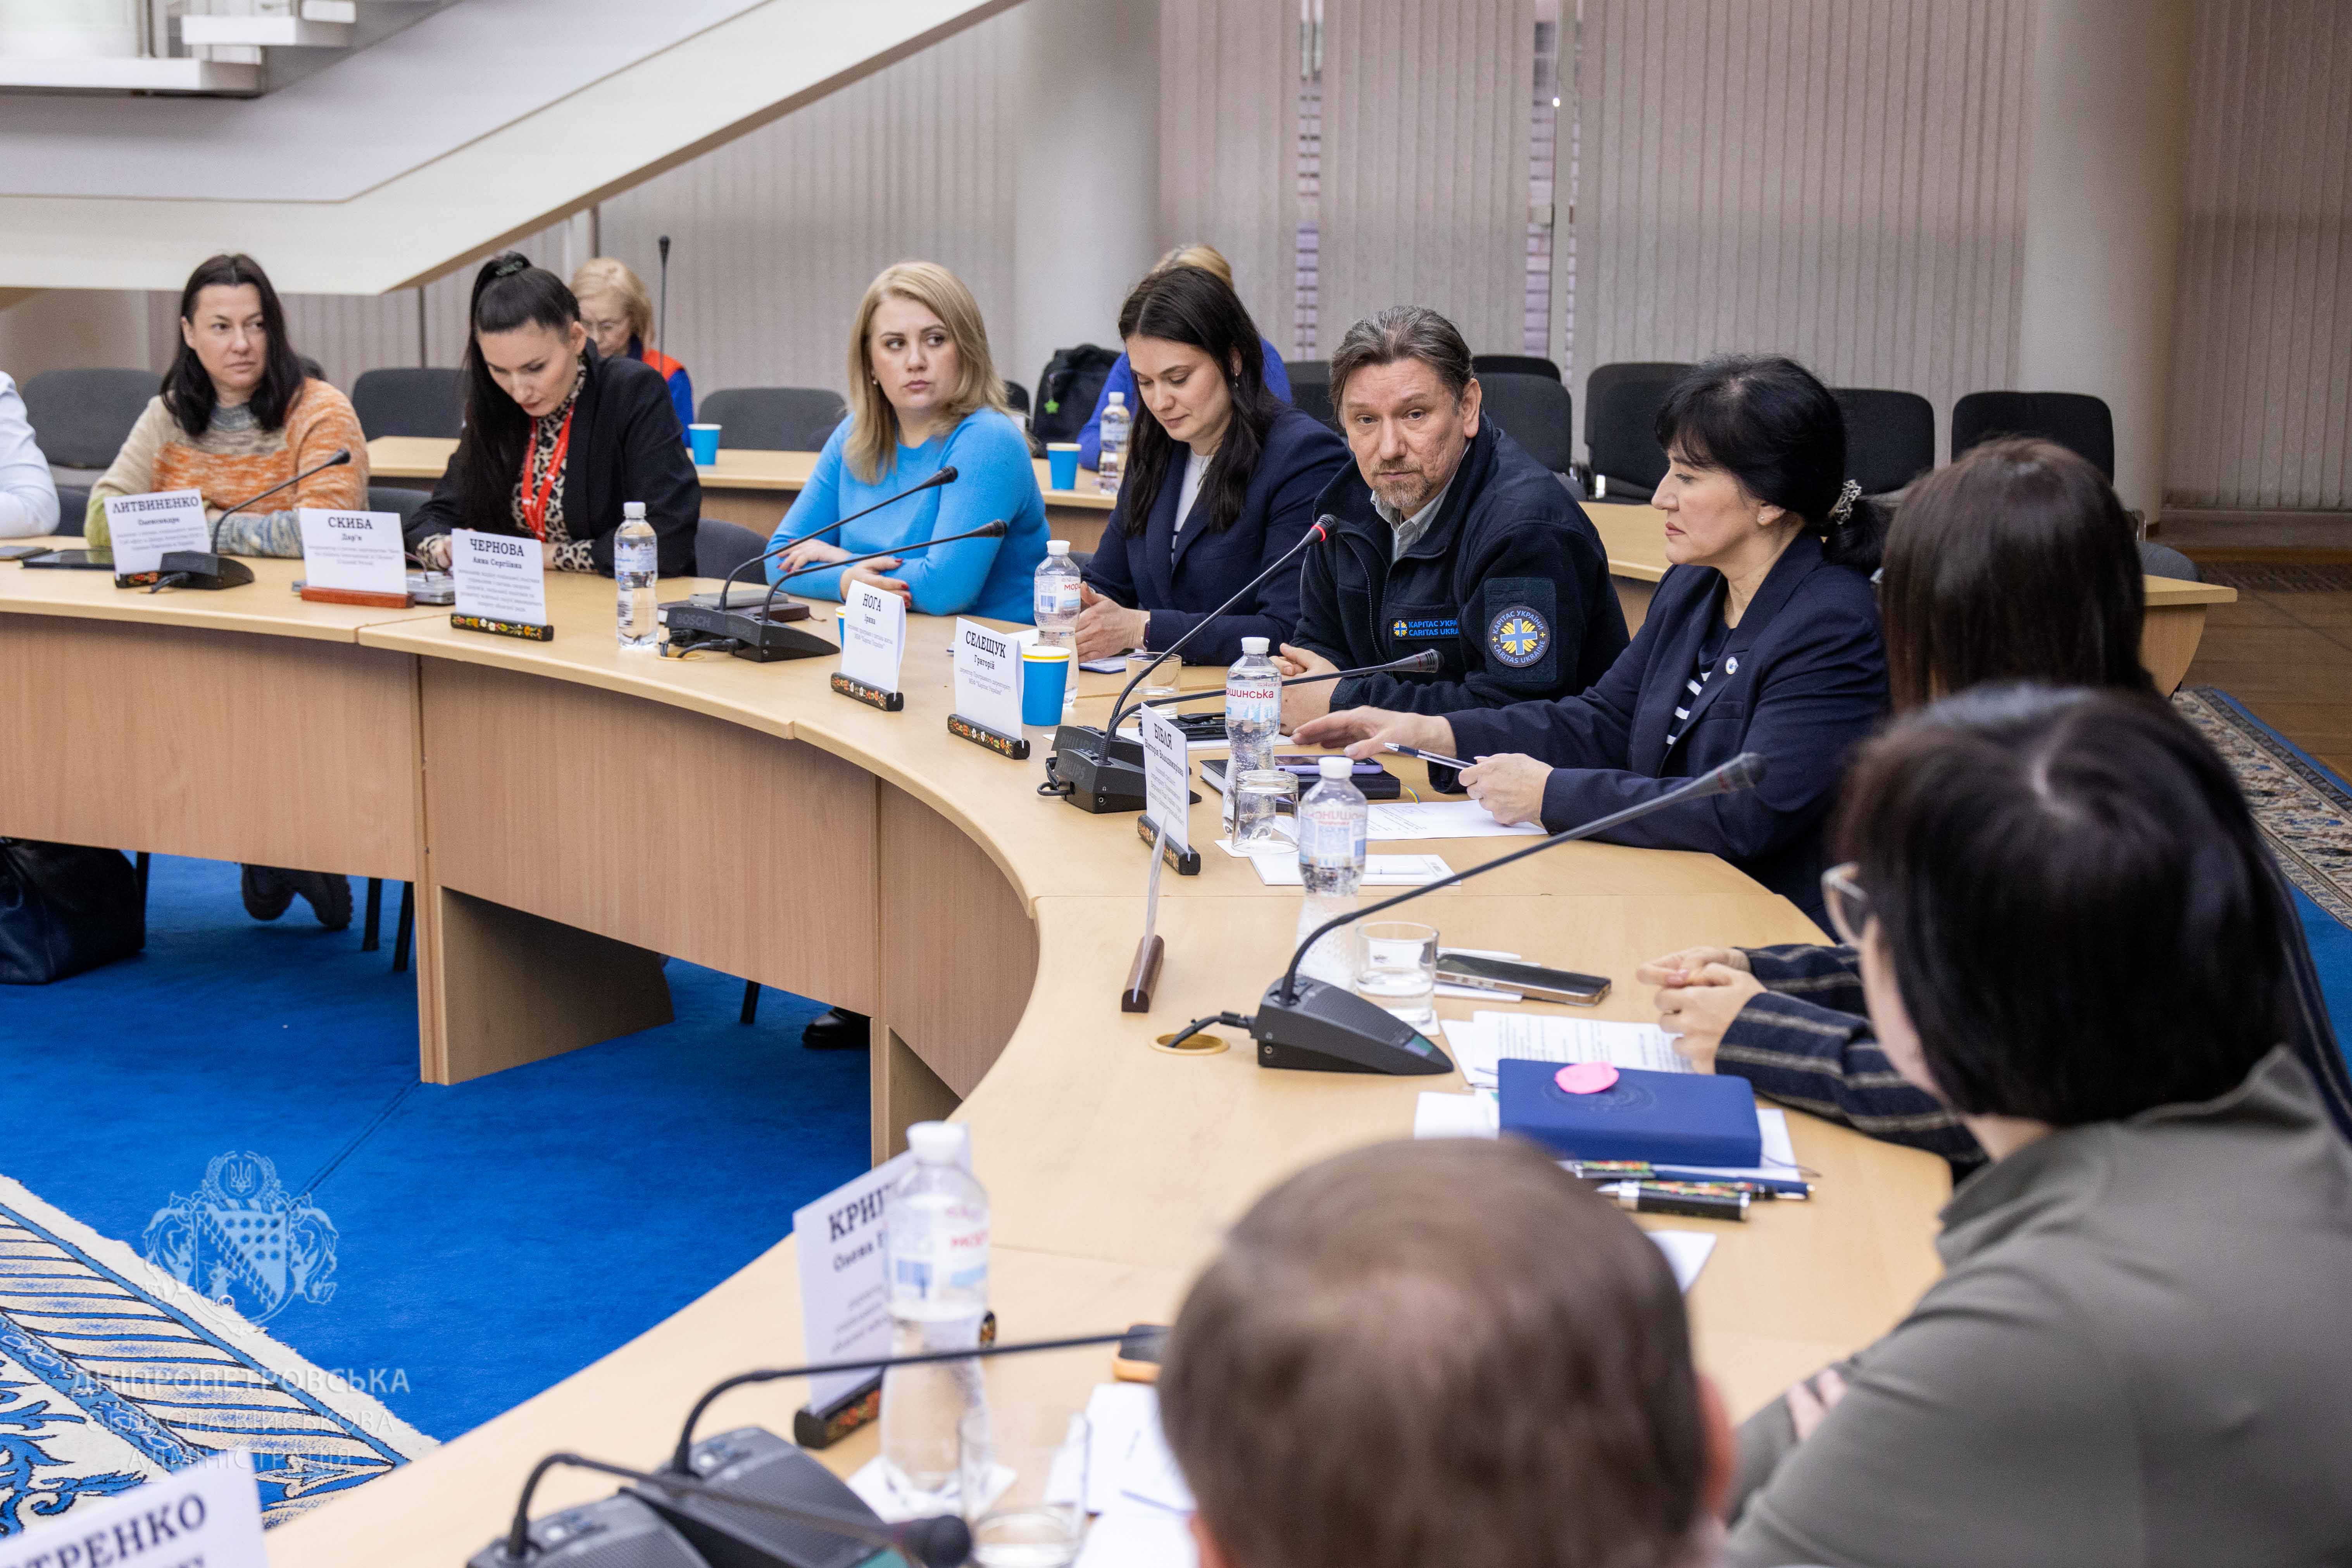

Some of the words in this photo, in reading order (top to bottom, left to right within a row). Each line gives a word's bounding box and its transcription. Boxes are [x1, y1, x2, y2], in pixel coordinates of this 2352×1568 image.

[113, 497, 199, 514] ЛИТВИНЕНКО
[328, 516, 373, 529] СКИБА
[470, 538, 524, 557] ЧЕРНОВА
[862, 593, 881, 612] НОГА
[1492, 611, 1515, 634] КАРІТАС
[1516, 610, 1544, 630] УКРАЇНИ
[966, 630, 1006, 659] СЕЛЕЩУК
[1494, 644, 1519, 664] CARITAS
[1521, 640, 1545, 663] UKRAINE
[974, 654, 995, 670] Григорій
[1154, 723, 1173, 750] БІБЛЯ
